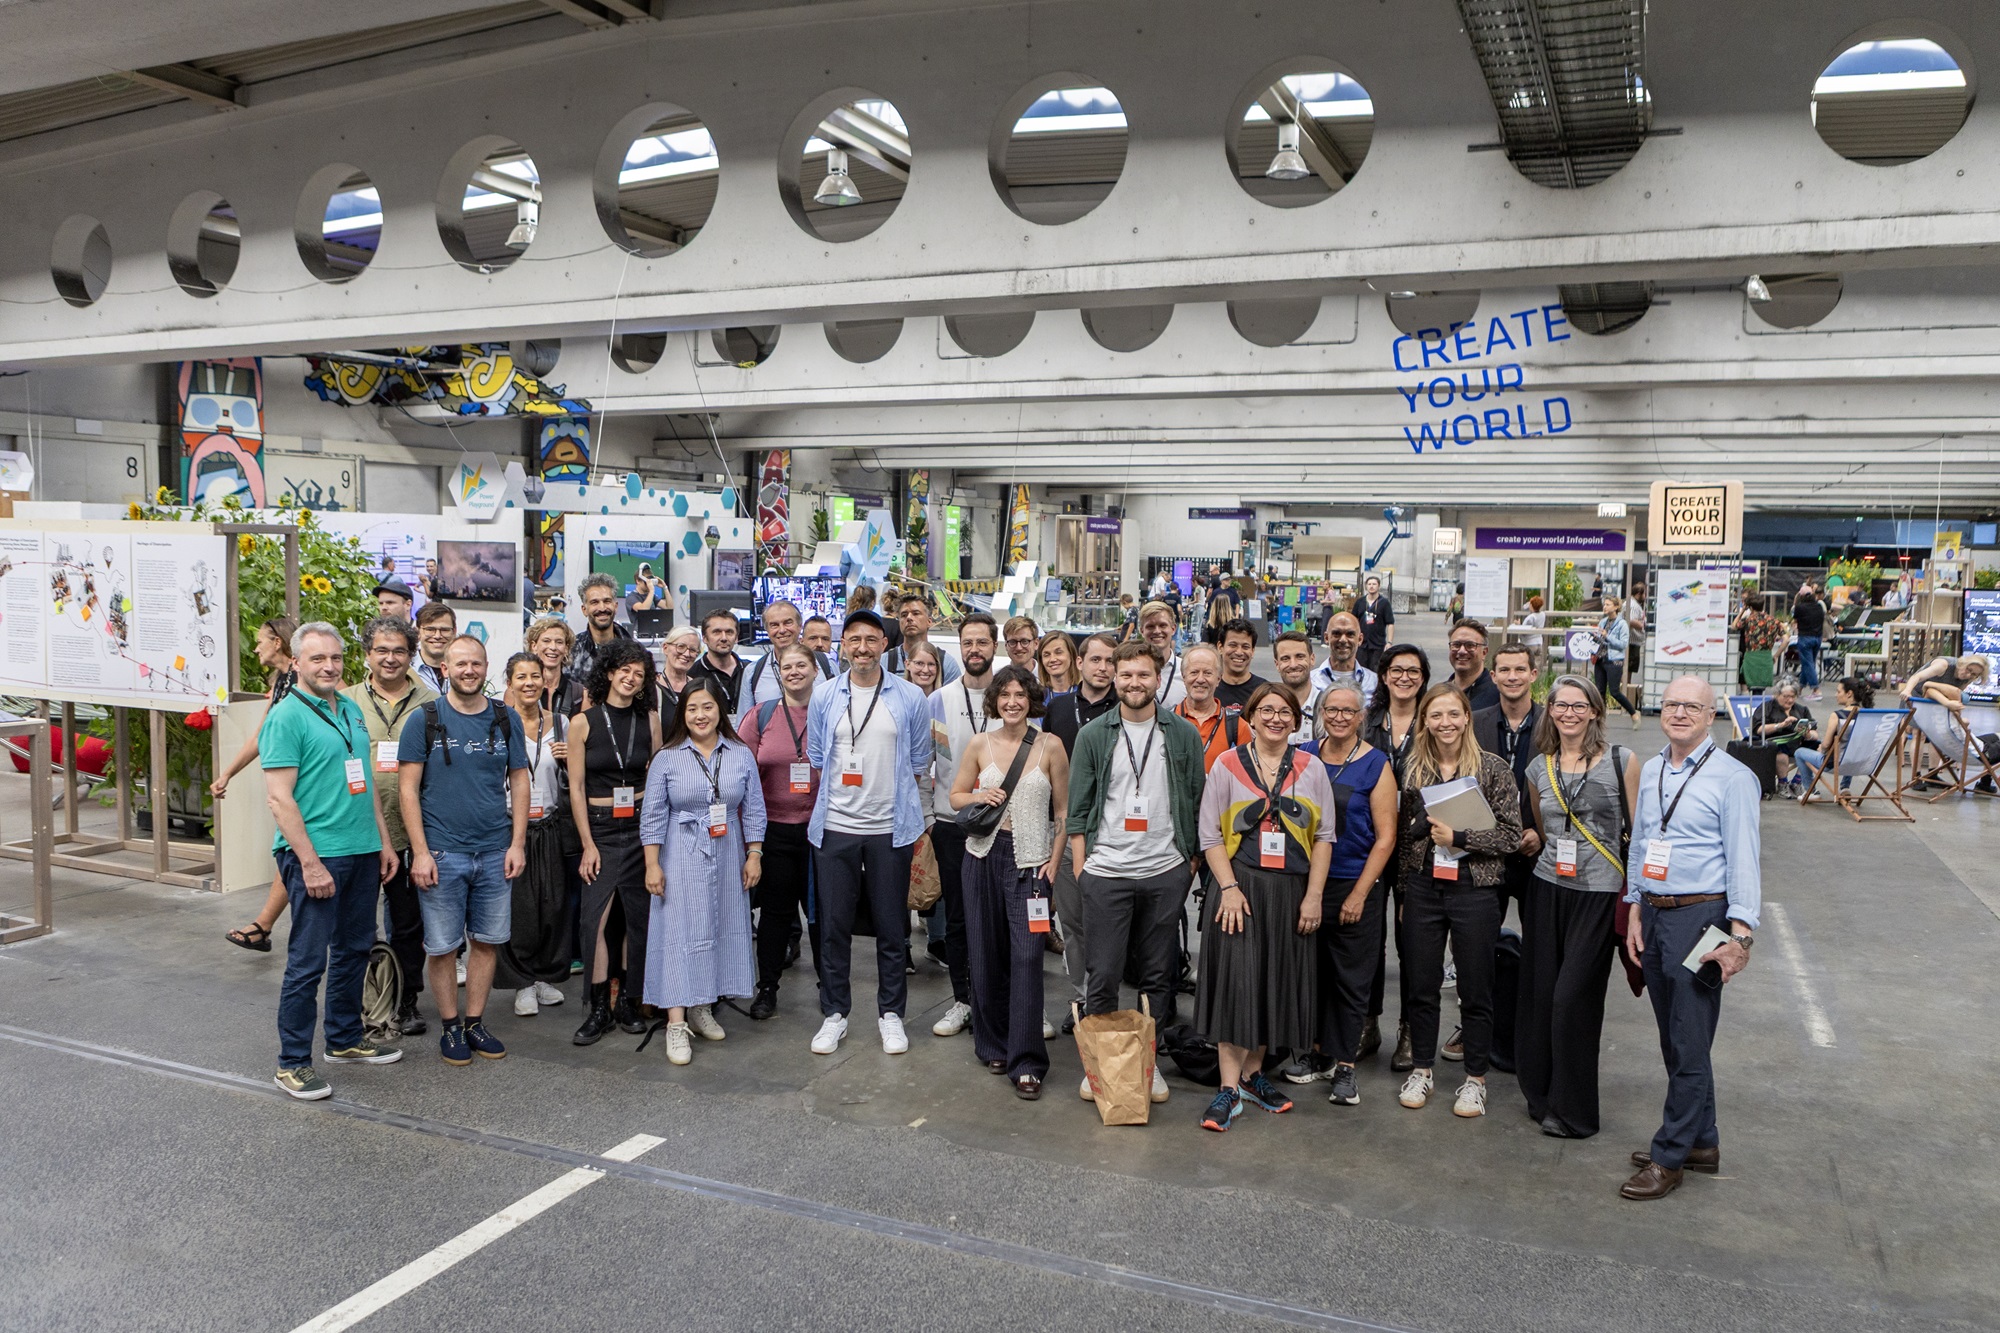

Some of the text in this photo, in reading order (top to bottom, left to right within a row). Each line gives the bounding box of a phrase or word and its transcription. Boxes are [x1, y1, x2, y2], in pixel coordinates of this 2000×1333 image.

[1392, 303, 1571, 373] CREATE
[1396, 363, 1526, 414] YOUR
[1403, 396, 1573, 455] WORLD
[126, 457, 138, 478] 8
[341, 470, 351, 489] 9
[468, 501, 495, 509] Playground
[1670, 496, 1721, 507] CREATE
[1670, 509, 1720, 522] YOUR
[1669, 525, 1720, 536] WORLD
[1496, 535, 1604, 546] create your world Infopoint
